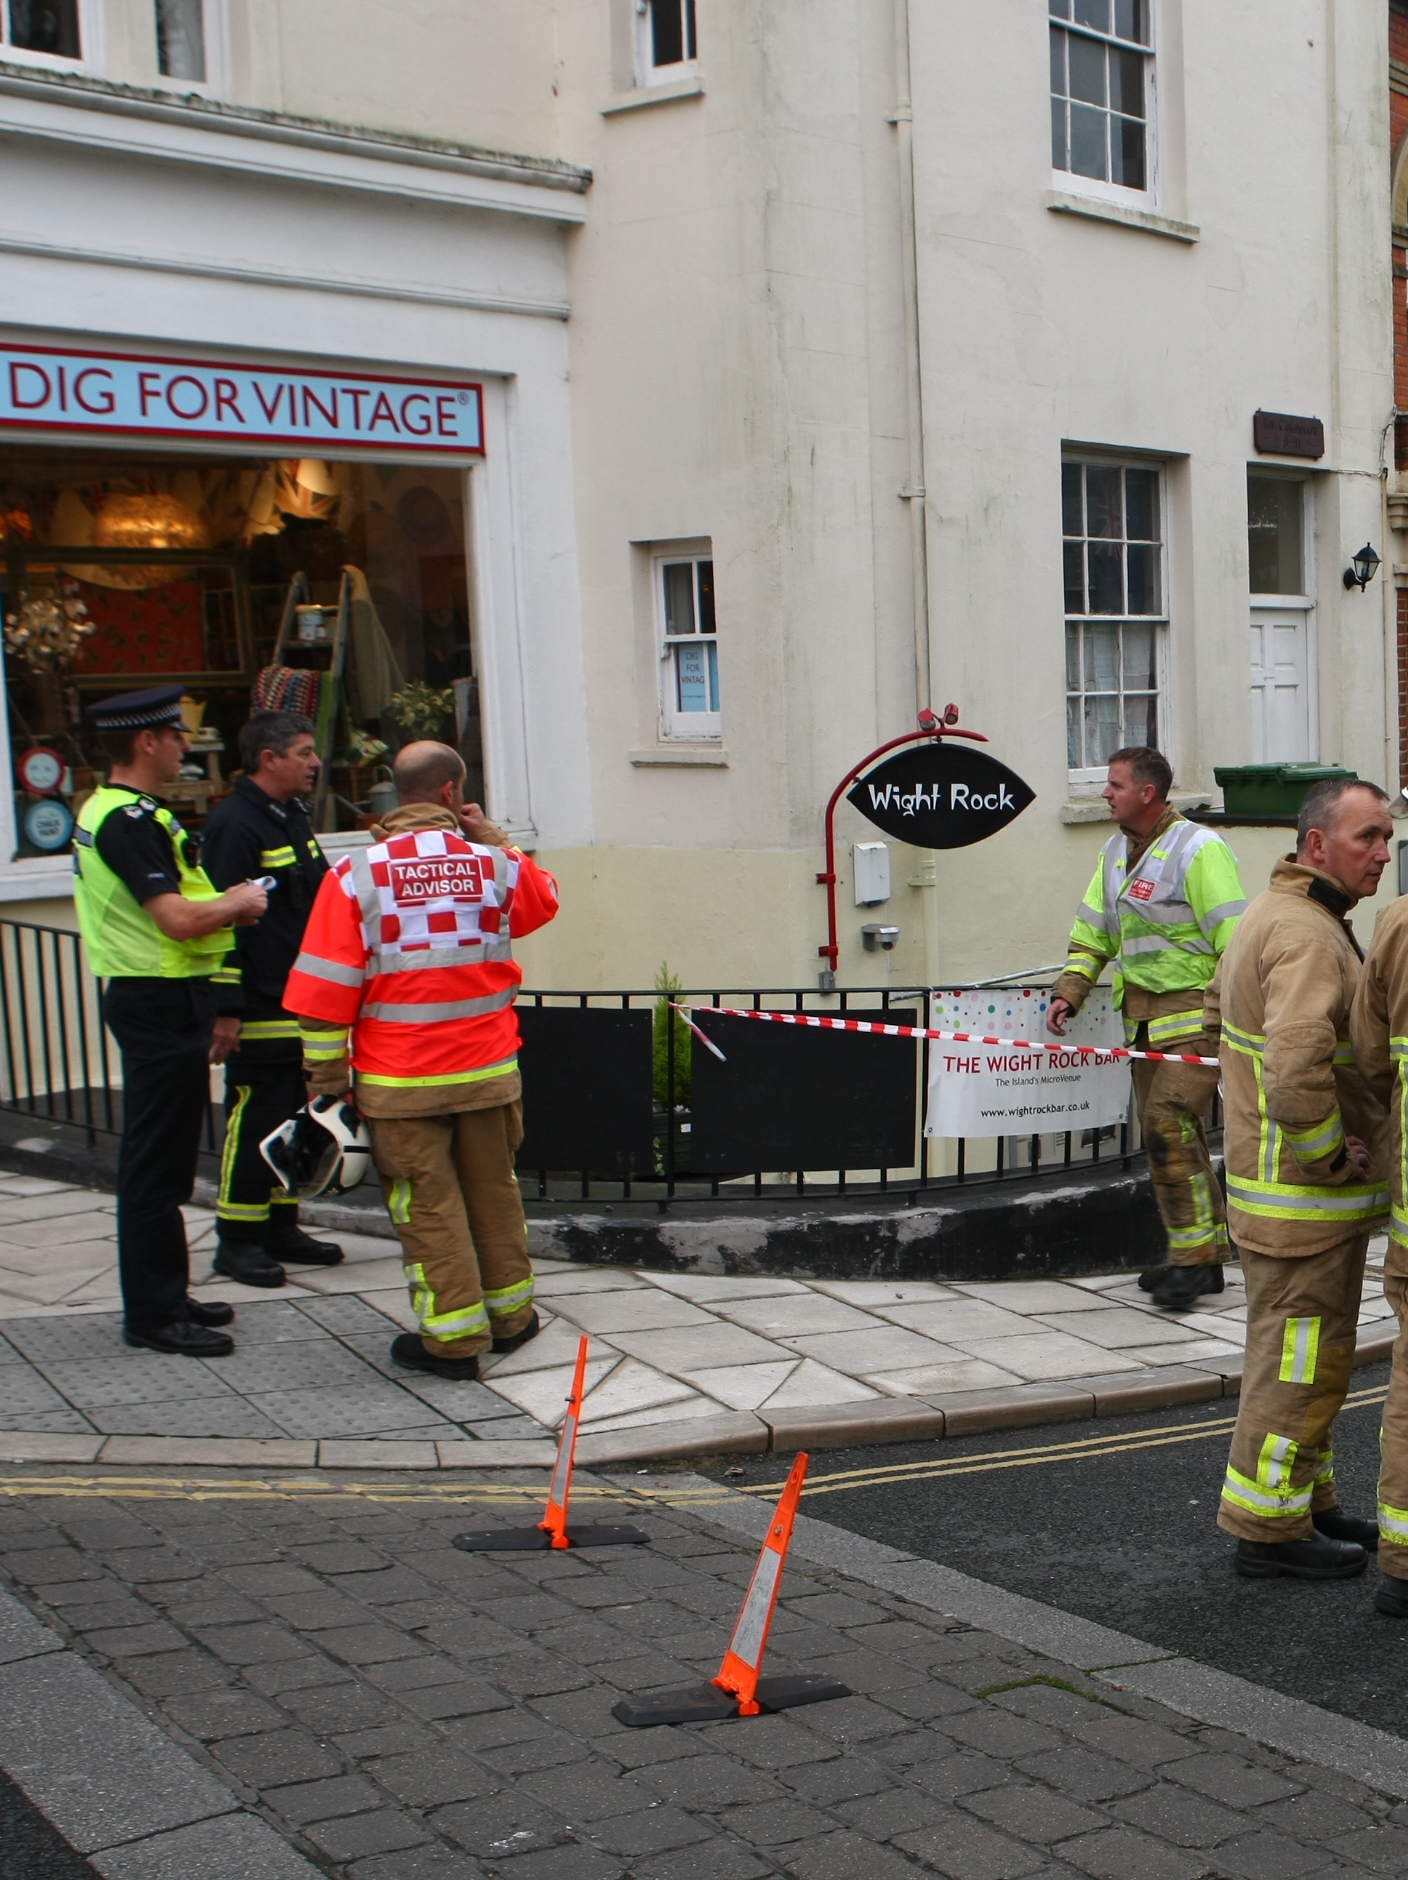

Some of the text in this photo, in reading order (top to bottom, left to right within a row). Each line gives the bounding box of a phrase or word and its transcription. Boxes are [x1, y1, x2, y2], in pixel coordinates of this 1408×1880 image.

[8, 361, 116, 415] DIG
[138, 371, 247, 424] FOR
[1263, 417, 1275, 430] THE
[686, 652, 699, 660] DIG
[686, 664, 700, 672] FOR
[868, 783, 1015, 817] Wight Rock
[395, 863, 476, 880] TACTICAL
[402, 879, 475, 897] ADVISOR
[1133, 880, 1154, 891] FIRE
[943, 1051, 1120, 1074] THE WIGHT ROCK BAR
[995, 1074, 1082, 1087] The Island's MicroVenue
[981, 1101, 1090, 1119] www.wightrockbar.co.uk
